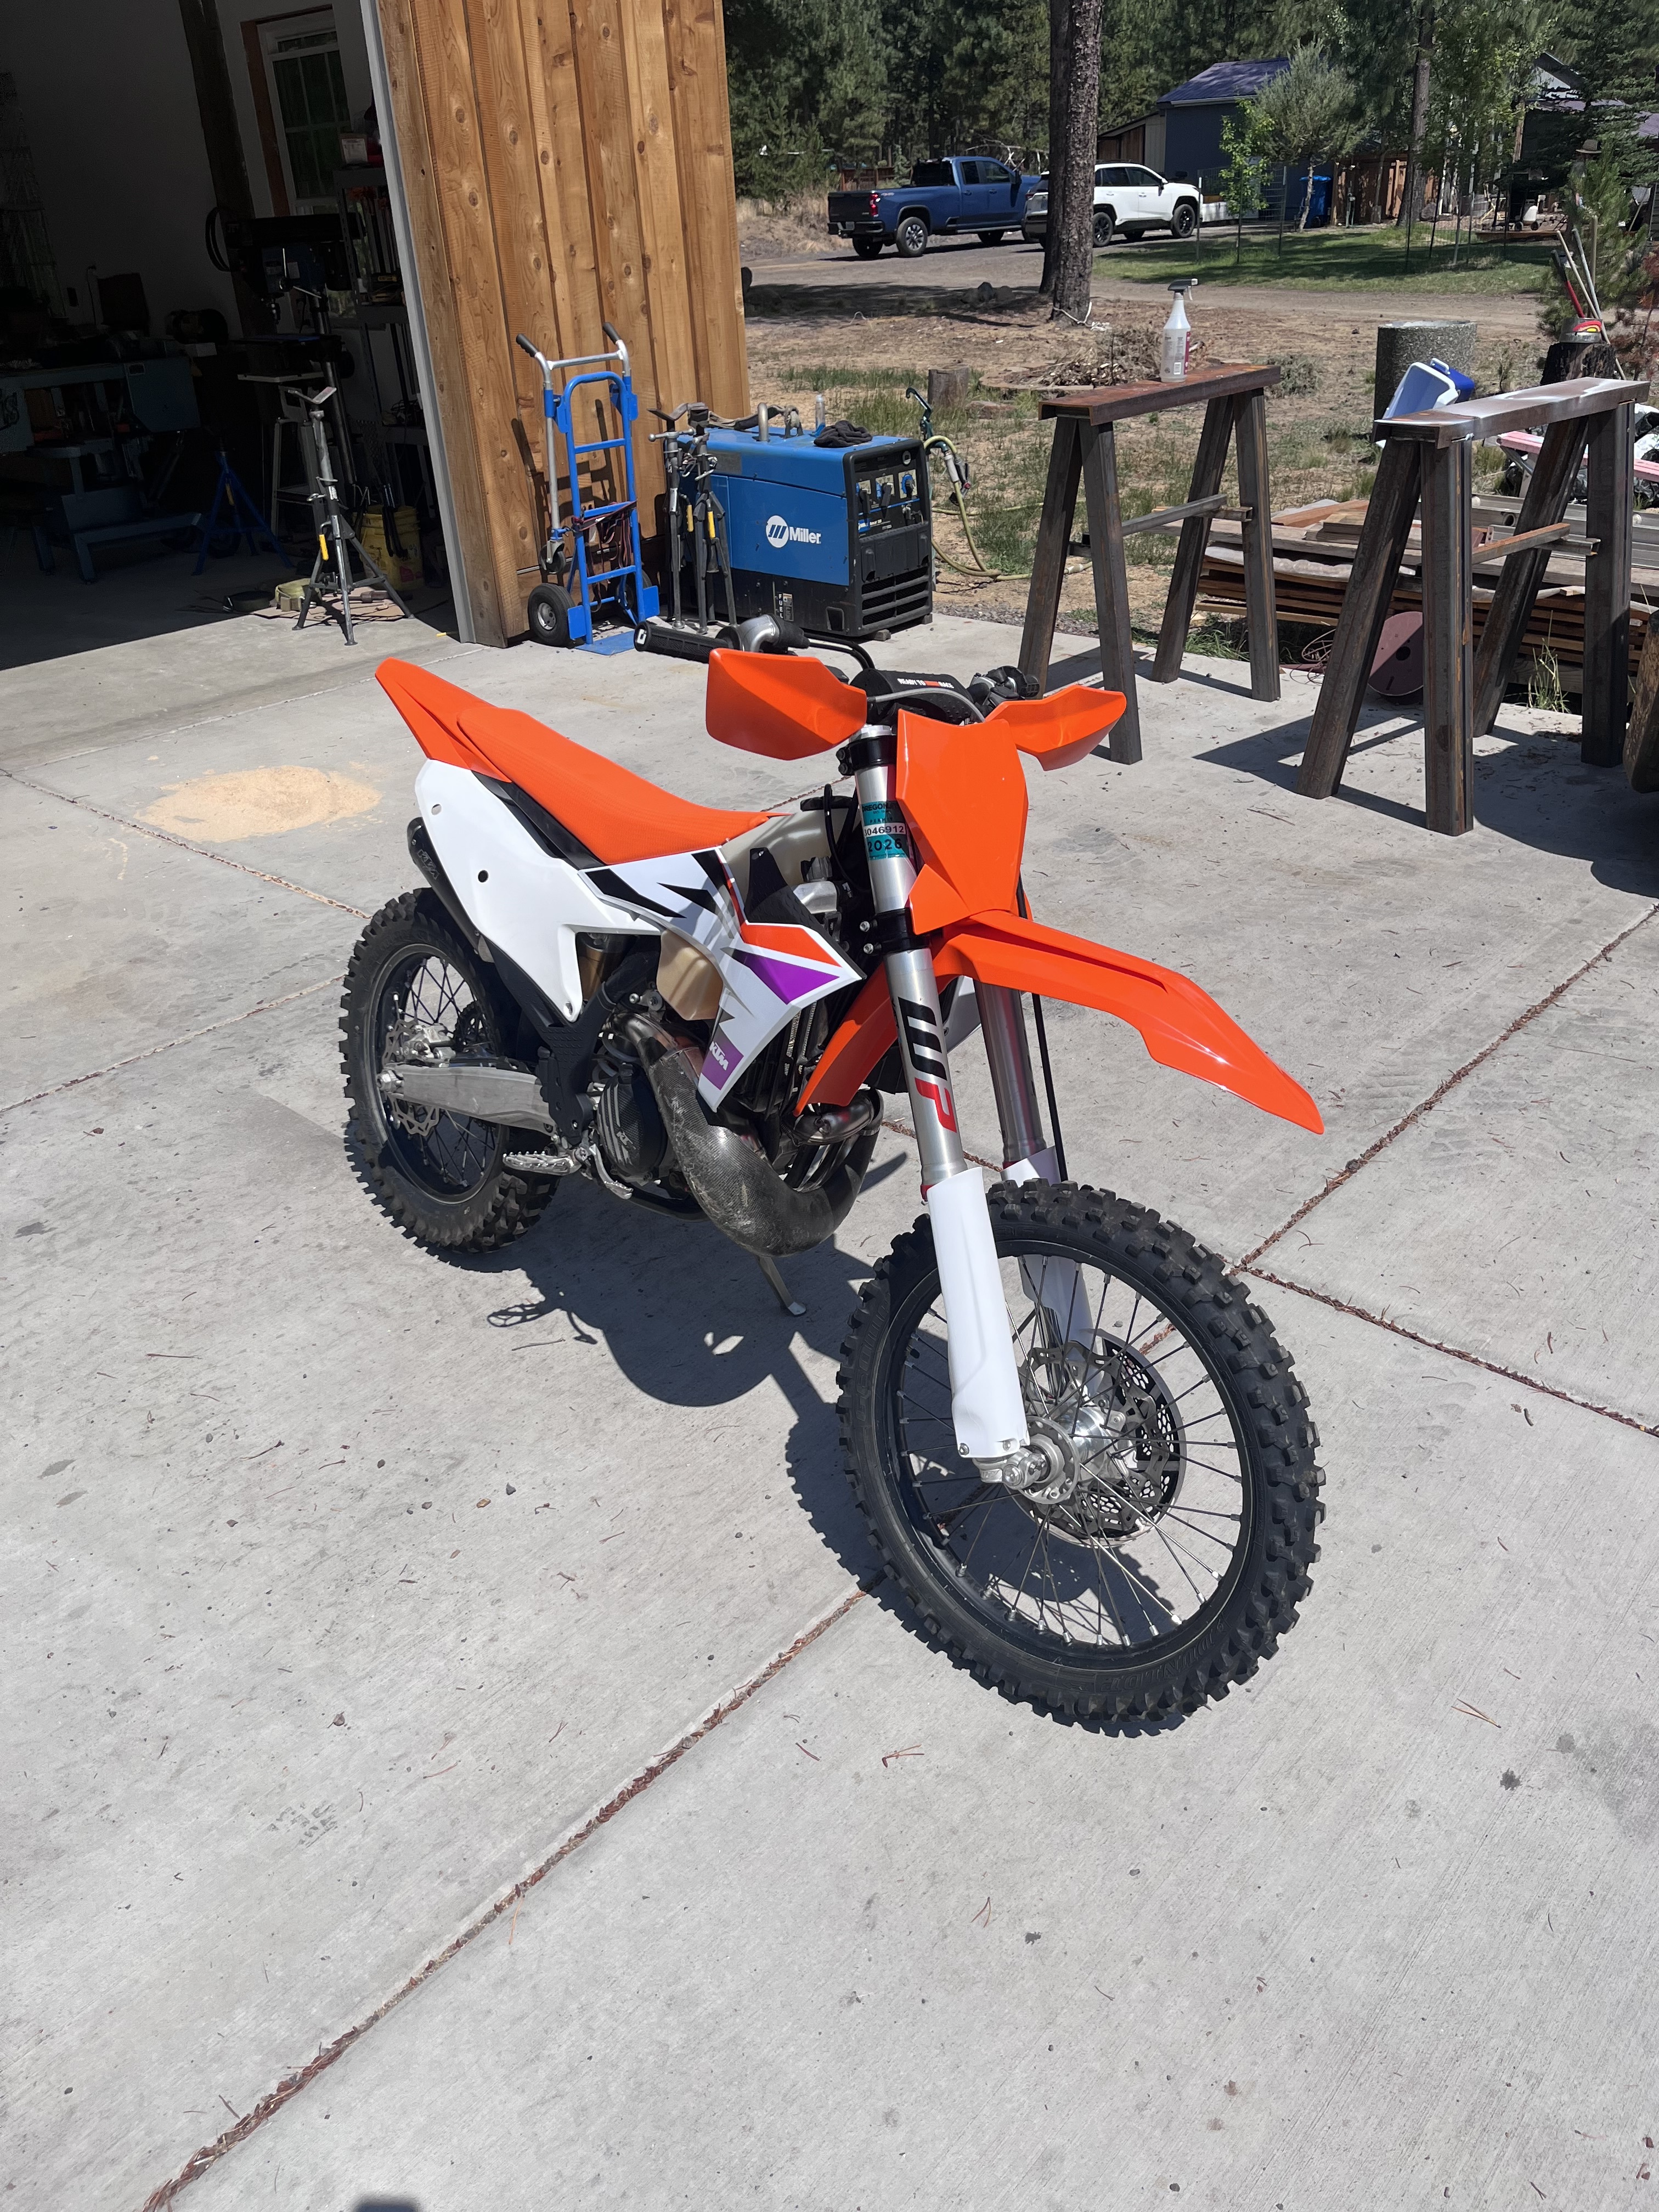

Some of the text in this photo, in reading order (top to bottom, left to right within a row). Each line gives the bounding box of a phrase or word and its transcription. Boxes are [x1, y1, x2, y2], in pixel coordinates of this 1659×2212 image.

[789, 526, 821, 544] Miller
[867, 838, 902, 852] 2026
[709, 1041, 729, 1071] KTM
[898, 996, 957, 1133] WP
